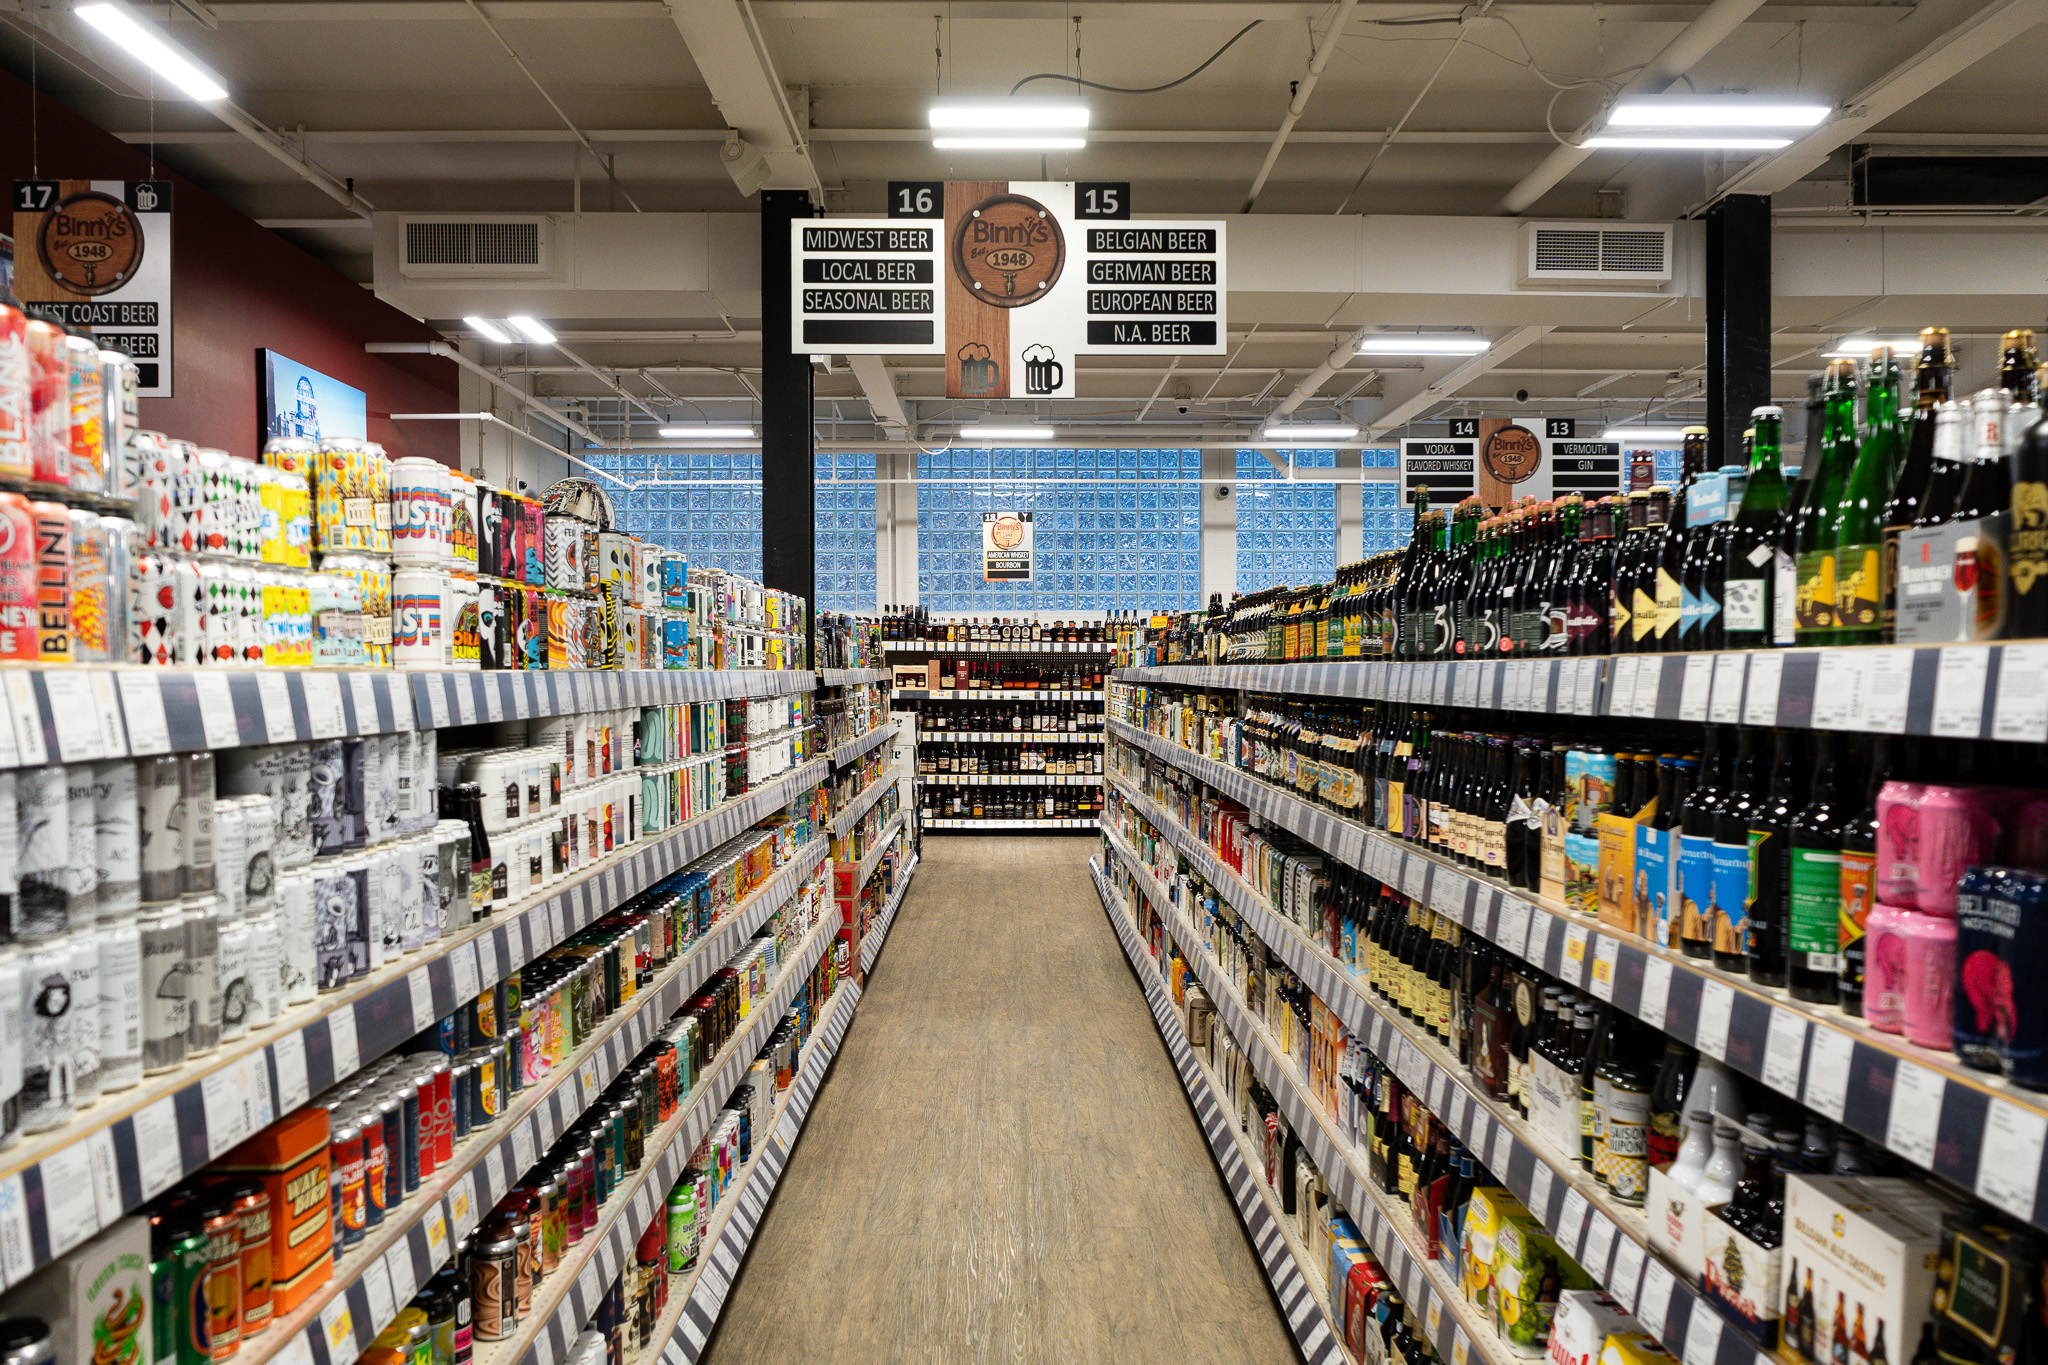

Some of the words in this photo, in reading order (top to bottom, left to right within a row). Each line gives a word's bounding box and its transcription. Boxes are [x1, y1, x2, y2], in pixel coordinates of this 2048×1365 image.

[20, 185, 52, 209] 17
[898, 188, 933, 213] 16
[1084, 189, 1119, 214] 15
[56, 212, 127, 240] Binny's
[973, 217, 1049, 247] Binny's
[806, 231, 884, 250] MIDWEST
[889, 231, 928, 250] BEER
[1095, 232, 1164, 251] BELGIAN
[1168, 232, 1207, 251] BEER
[74, 244, 107, 258] 1948
[992, 252, 1028, 266] 1948
[822, 262, 873, 282] LOCAL
[877, 262, 916, 282] BEER
[1092, 263, 1165, 282] GERMAN
[1171, 263, 1211, 282] BEER
[805, 292, 889, 311] SEASONAL
[893, 292, 930, 311] BEER
[1092, 293, 1173, 312] EUROPEAN
[1177, 293, 1213, 312] BEER
[71, 304, 118, 323] COAST
[121, 304, 156, 323] BEER
[1113, 324, 1148, 343] N.A.
[1151, 324, 1190, 343] BEER
[120, 336, 157, 355] BEER
[1455, 421, 1474, 435] 14
[1550, 421, 1569, 435] 13
[1424, 444, 1456, 455] VODKA
[1503, 455, 1522, 463] 1948
[1563, 444, 1607, 455] VERMOUTH
[1407, 460, 1442, 471] FLAVORED
[1443, 460, 1472, 471] WHISKEY
[1577, 460, 1594, 471] GIN
[984, 513, 996, 522] 18
[987, 551, 1009, 559] AMERICAN
[1010, 551, 1029, 559] WHISKEY
[995, 561, 1021, 569] BOURBON
[38, 520, 67, 652] BELLINI
